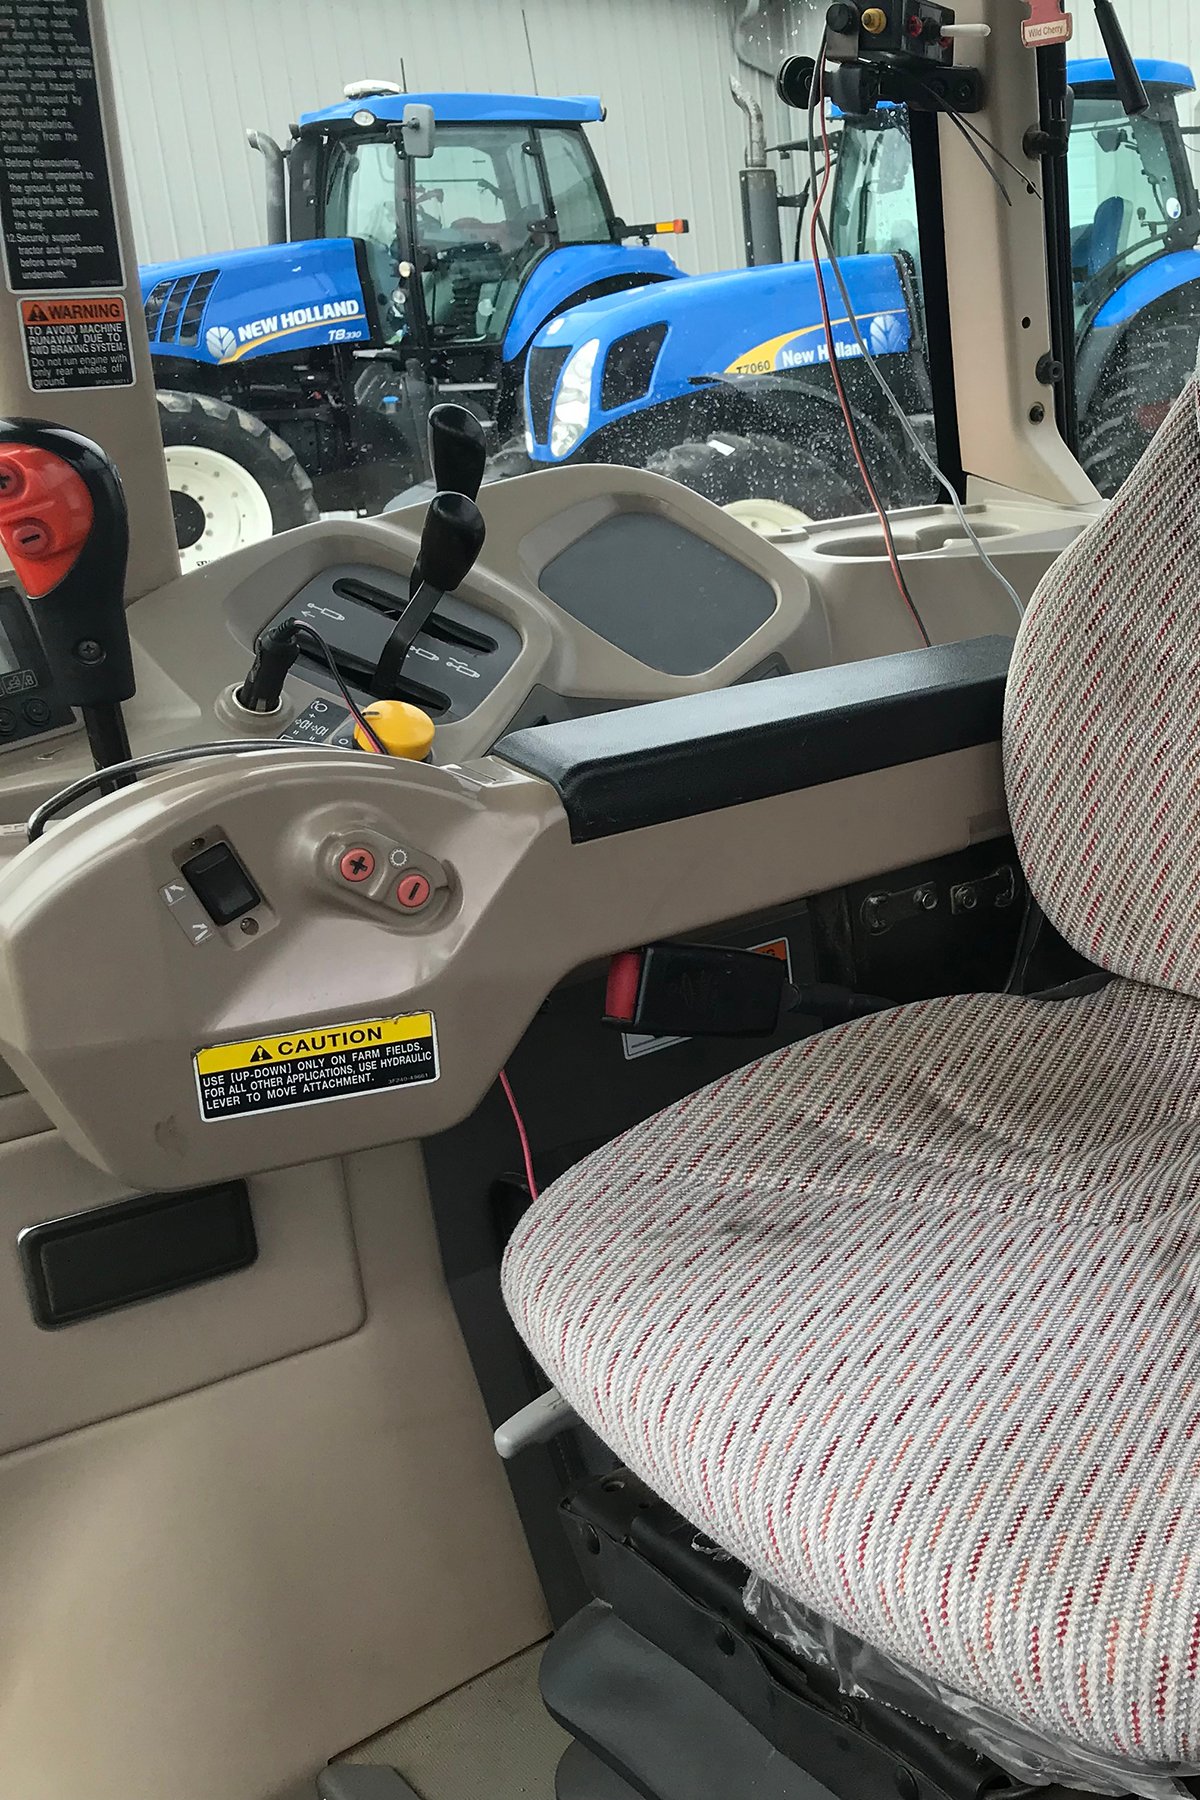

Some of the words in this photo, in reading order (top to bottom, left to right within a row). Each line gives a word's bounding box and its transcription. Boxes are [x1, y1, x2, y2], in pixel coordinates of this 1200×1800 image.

[1028, 27, 1042, 38] Wild
[1043, 25, 1063, 35] Cherry
[47, 303, 121, 320] WARNING
[27, 326, 43, 336] TO
[46, 325, 77, 336] AVOID
[79, 322, 124, 335] MACHINE
[237, 314, 277, 342] NEW
[279, 299, 360, 330] HOLLAND
[28, 334, 79, 346] RUNAWAY
[83, 333, 103, 344] DUE
[107, 332, 121, 342] TO
[50, 343, 89, 355] BRAKING
[782, 350, 814, 367] New
[817, 339, 869, 361] Hlland
[31, 357, 45, 368] Do
[47, 357, 62, 367] not
[63, 357, 79, 367] run
[80, 355, 108, 368] engine
[109, 353, 128, 364] with
[736, 359, 771, 374] T7060
[32, 367, 52, 380] only
[56, 367, 74, 377] rear
[77, 364, 108, 376] wheels
[111, 363, 123, 374] off
[277, 1026, 383, 1056] CAUTION
[203, 1075, 225, 1088] USE
[230, 1063, 292, 1083] [UP-DOWN]
[297, 1058, 325, 1075] ONLY
[331, 1054, 346, 1065] ON
[352, 1049, 380, 1062] FARM
[386, 1042, 424, 1056] FIELDS.
[204, 1087, 225, 1099] FOR
[228, 1081, 247, 1095] ALL
[250, 1076, 284, 1092] OTHER
[359, 1060, 378, 1073] USE
[380, 1050, 433, 1069] HYDRAULIC
[206, 1096, 241, 1111] LEVER
[245, 1092, 261, 1103] TO
[267, 1085, 298, 1100] MOVE
[303, 1073, 375, 1093] ATTACHMENT.
